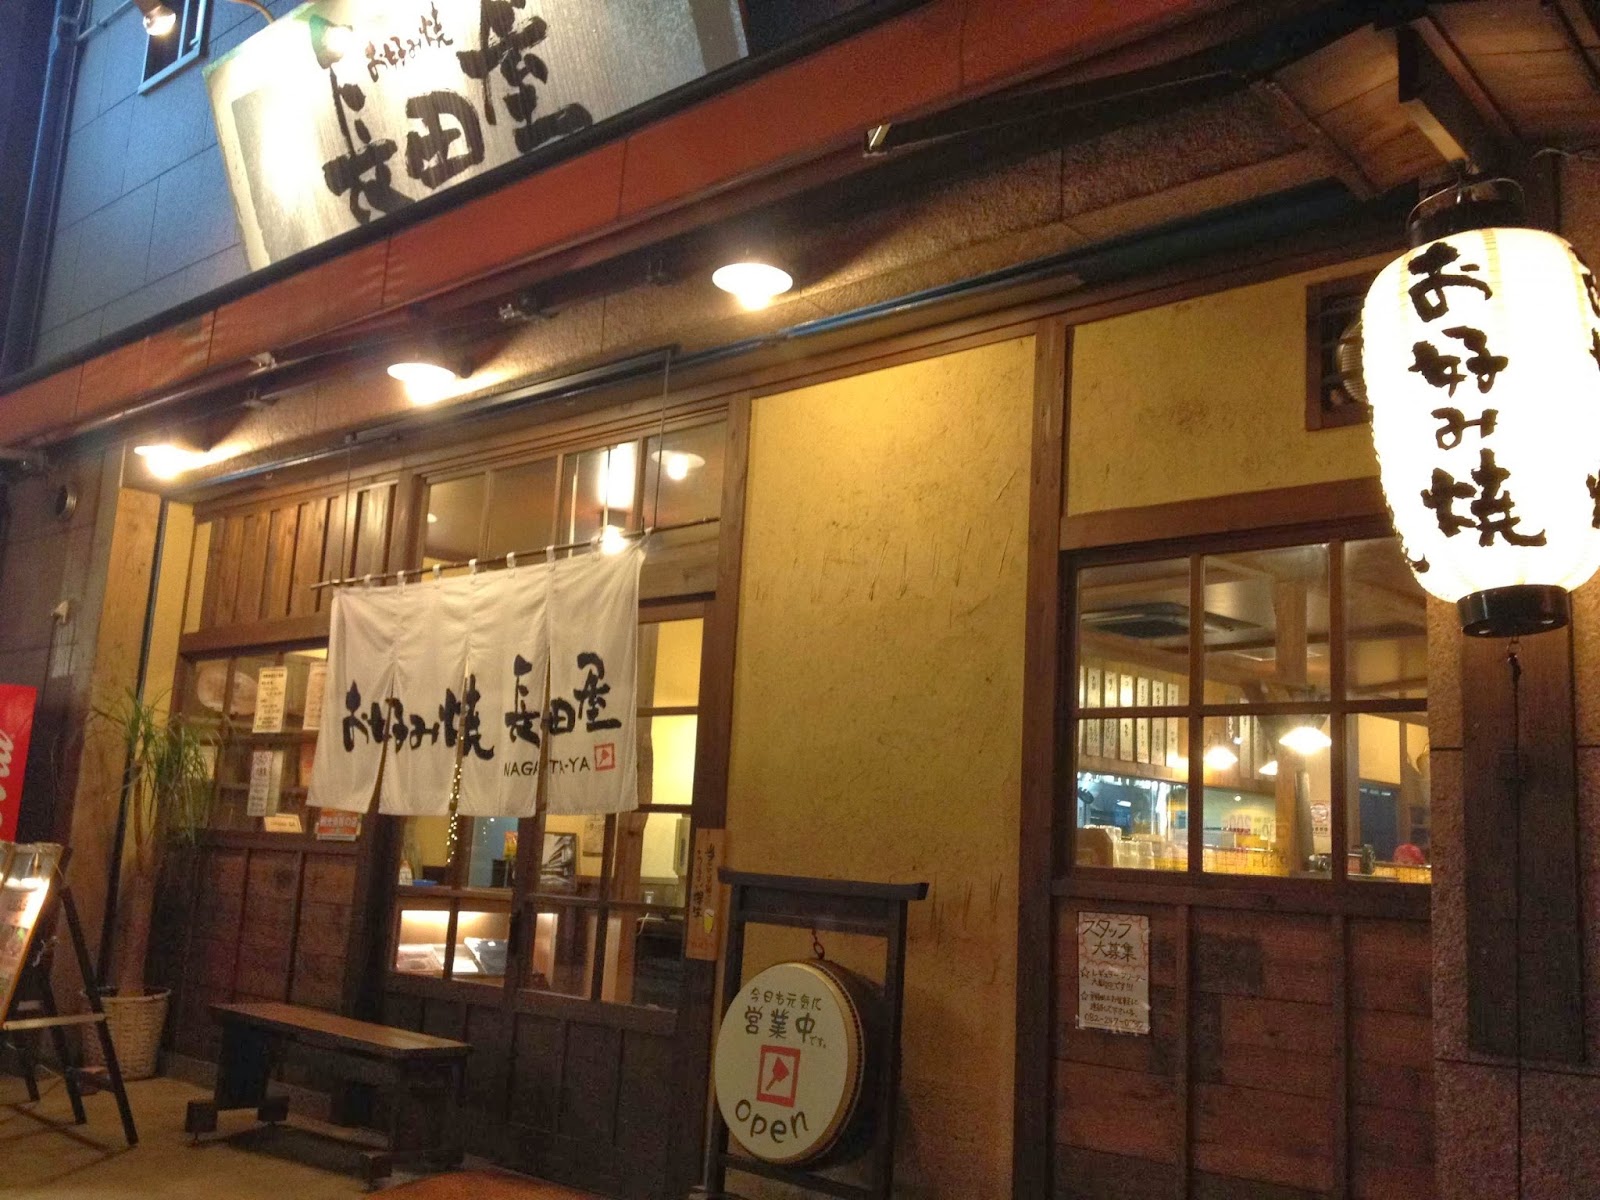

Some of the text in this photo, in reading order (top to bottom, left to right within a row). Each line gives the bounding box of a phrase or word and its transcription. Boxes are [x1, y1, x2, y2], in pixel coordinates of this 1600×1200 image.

[365, 1, 453, 82] お好み焼
[1408, 242, 1546, 547] お好み焼
[1083, 919, 1132, 939] スタッフ
[1092, 941, 1137, 962] 大募集
[750, 987, 822, 1011] 今日も元気に
